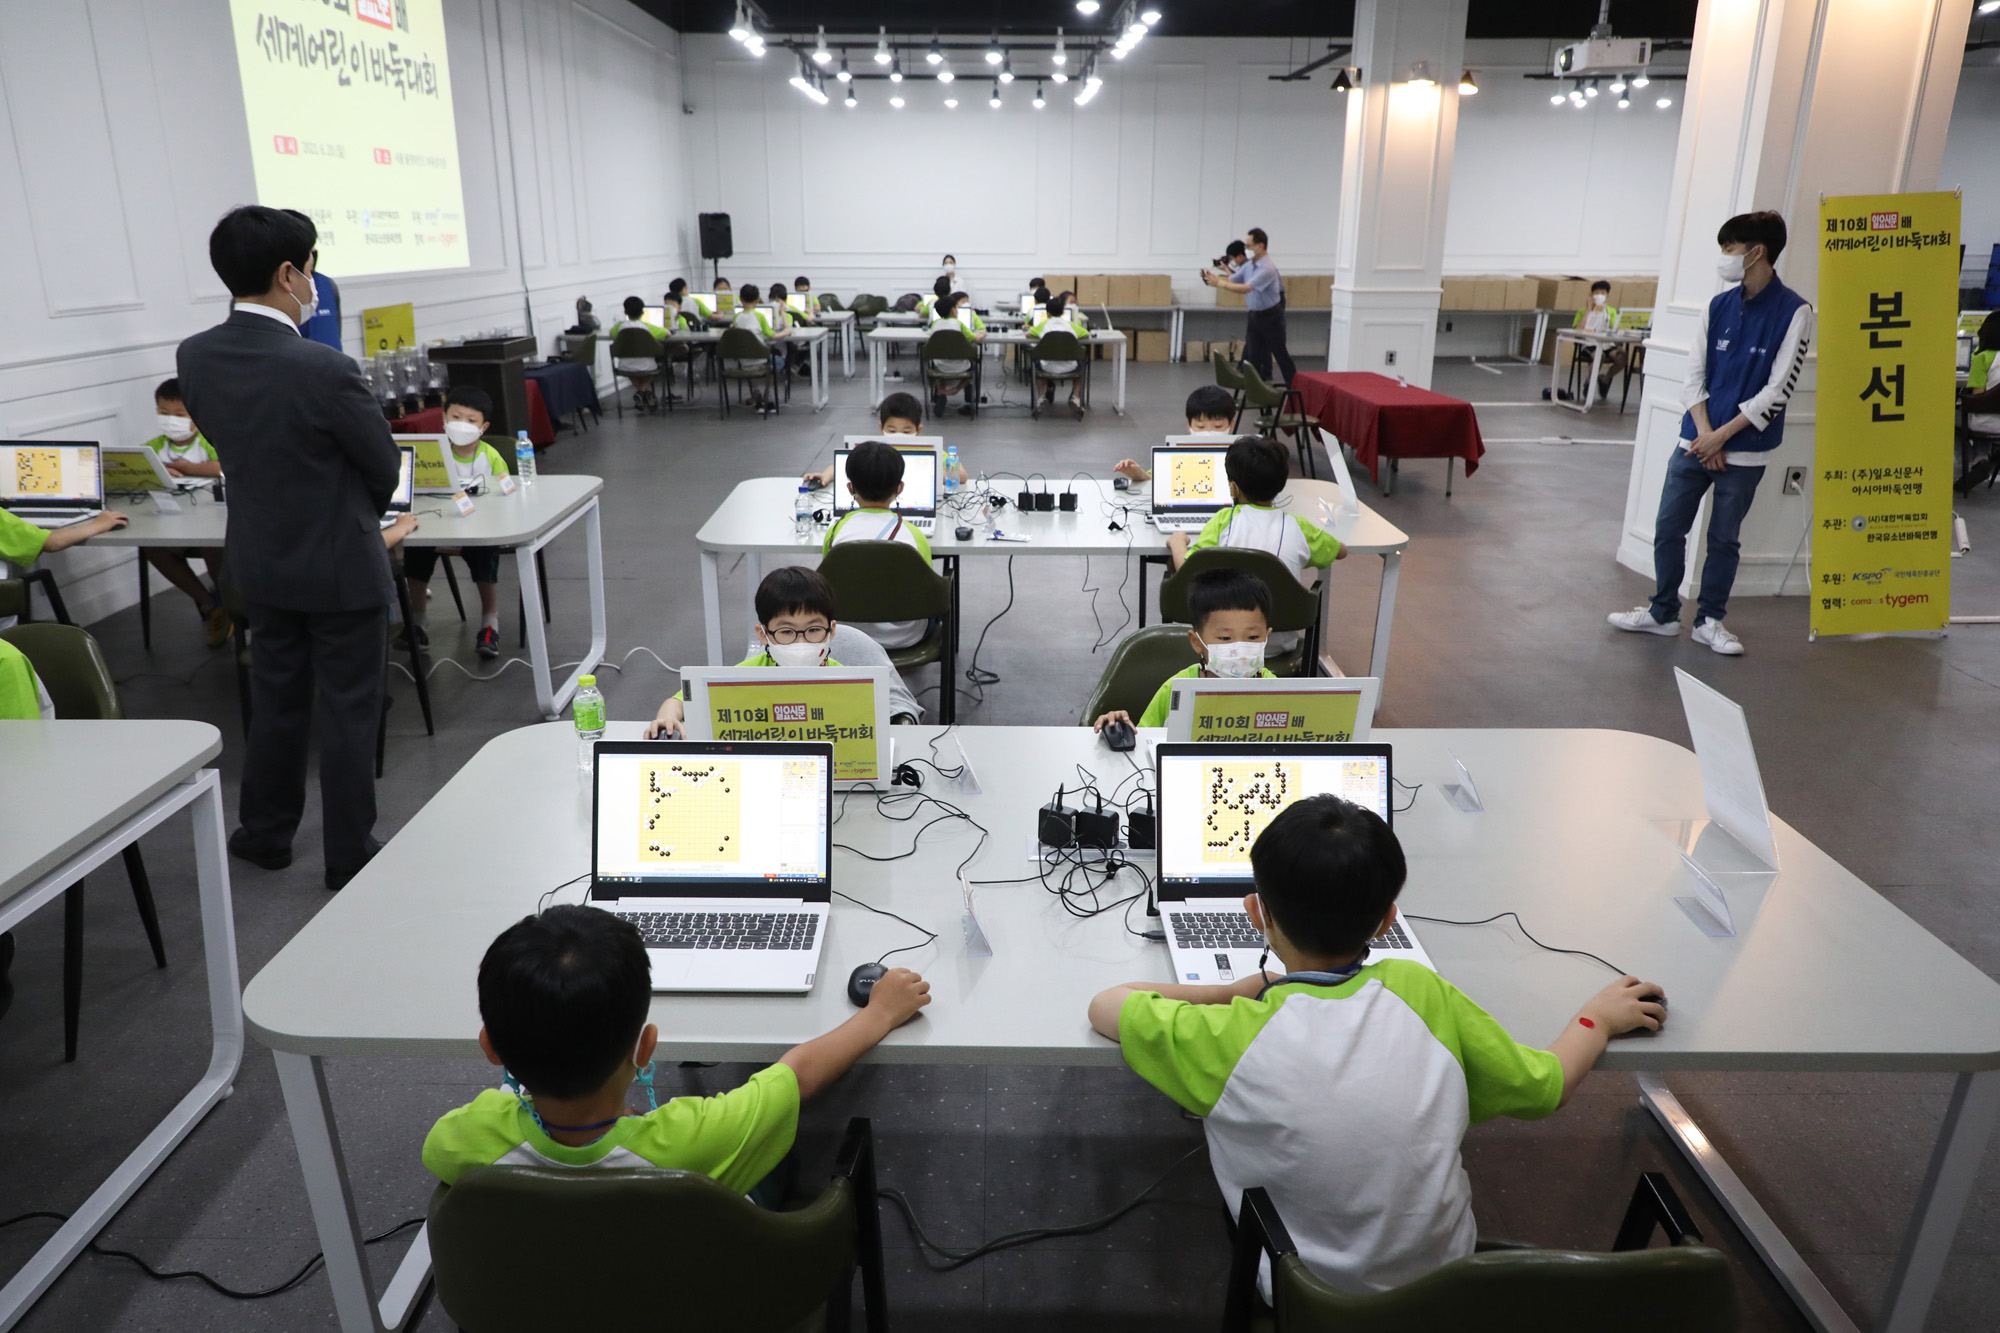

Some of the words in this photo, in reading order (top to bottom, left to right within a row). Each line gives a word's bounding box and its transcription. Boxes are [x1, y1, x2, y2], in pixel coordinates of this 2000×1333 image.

[256, 13, 439, 101] 세계어린이바둑대회
[1826, 217, 1868, 232] 제10회
[1871, 213, 1898, 230] 일요신문
[1901, 216, 1912, 229] 배
[1825, 231, 1951, 252] 세계어린이바둑대회
[1824, 469, 1847, 481] 주최:
[1852, 466, 1924, 482] (주)일요신문사
[1852, 483, 1923, 496] 아시아바둑연맹
[1823, 518, 1847, 530] 주관:
[1822, 573, 1846, 585] 후원:
[1852, 572, 1883, 581] KSPO
[1886, 594, 1929, 608] tygem
[717, 707, 769, 723] 제10회
[774, 705, 807, 721] 일요신문
[811, 707, 824, 721] 배
[1198, 715, 1250, 729] 제10회
[1255, 713, 1288, 727] 일요신문
[1291, 716, 1305, 728] 배
